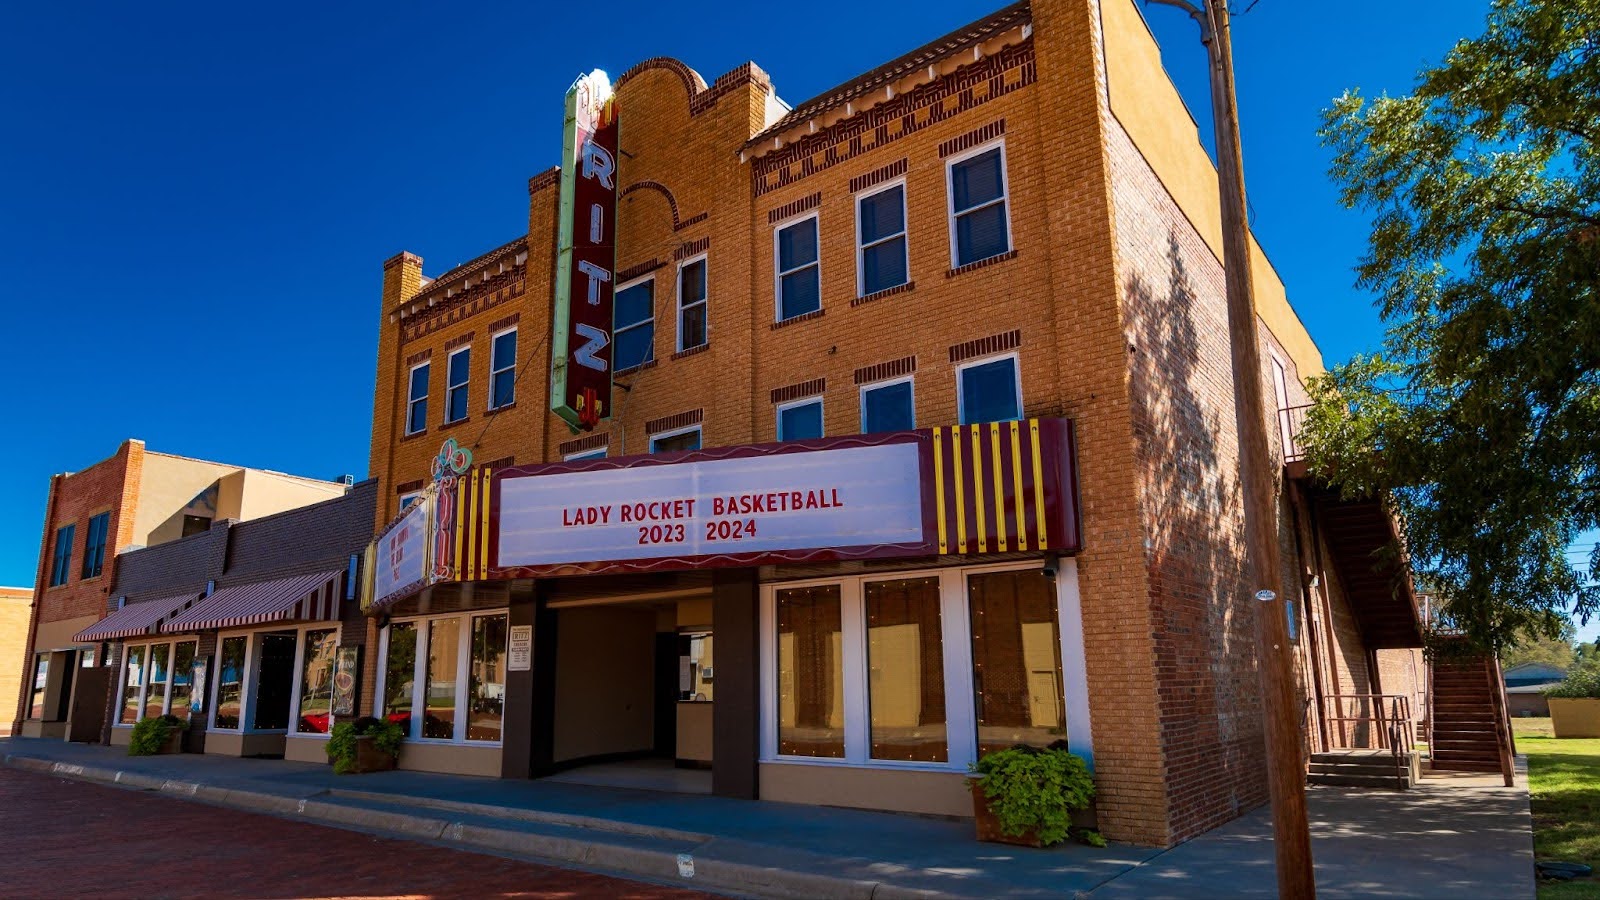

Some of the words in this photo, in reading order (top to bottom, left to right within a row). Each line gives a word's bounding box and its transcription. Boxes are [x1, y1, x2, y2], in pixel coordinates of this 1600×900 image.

[574, 139, 616, 372] RITZ
[563, 506, 612, 526] LADY
[620, 499, 696, 522] ROCKET
[713, 489, 843, 516] BASKETBALL
[638, 524, 685, 544] 2023
[706, 519, 757, 540] 2024
